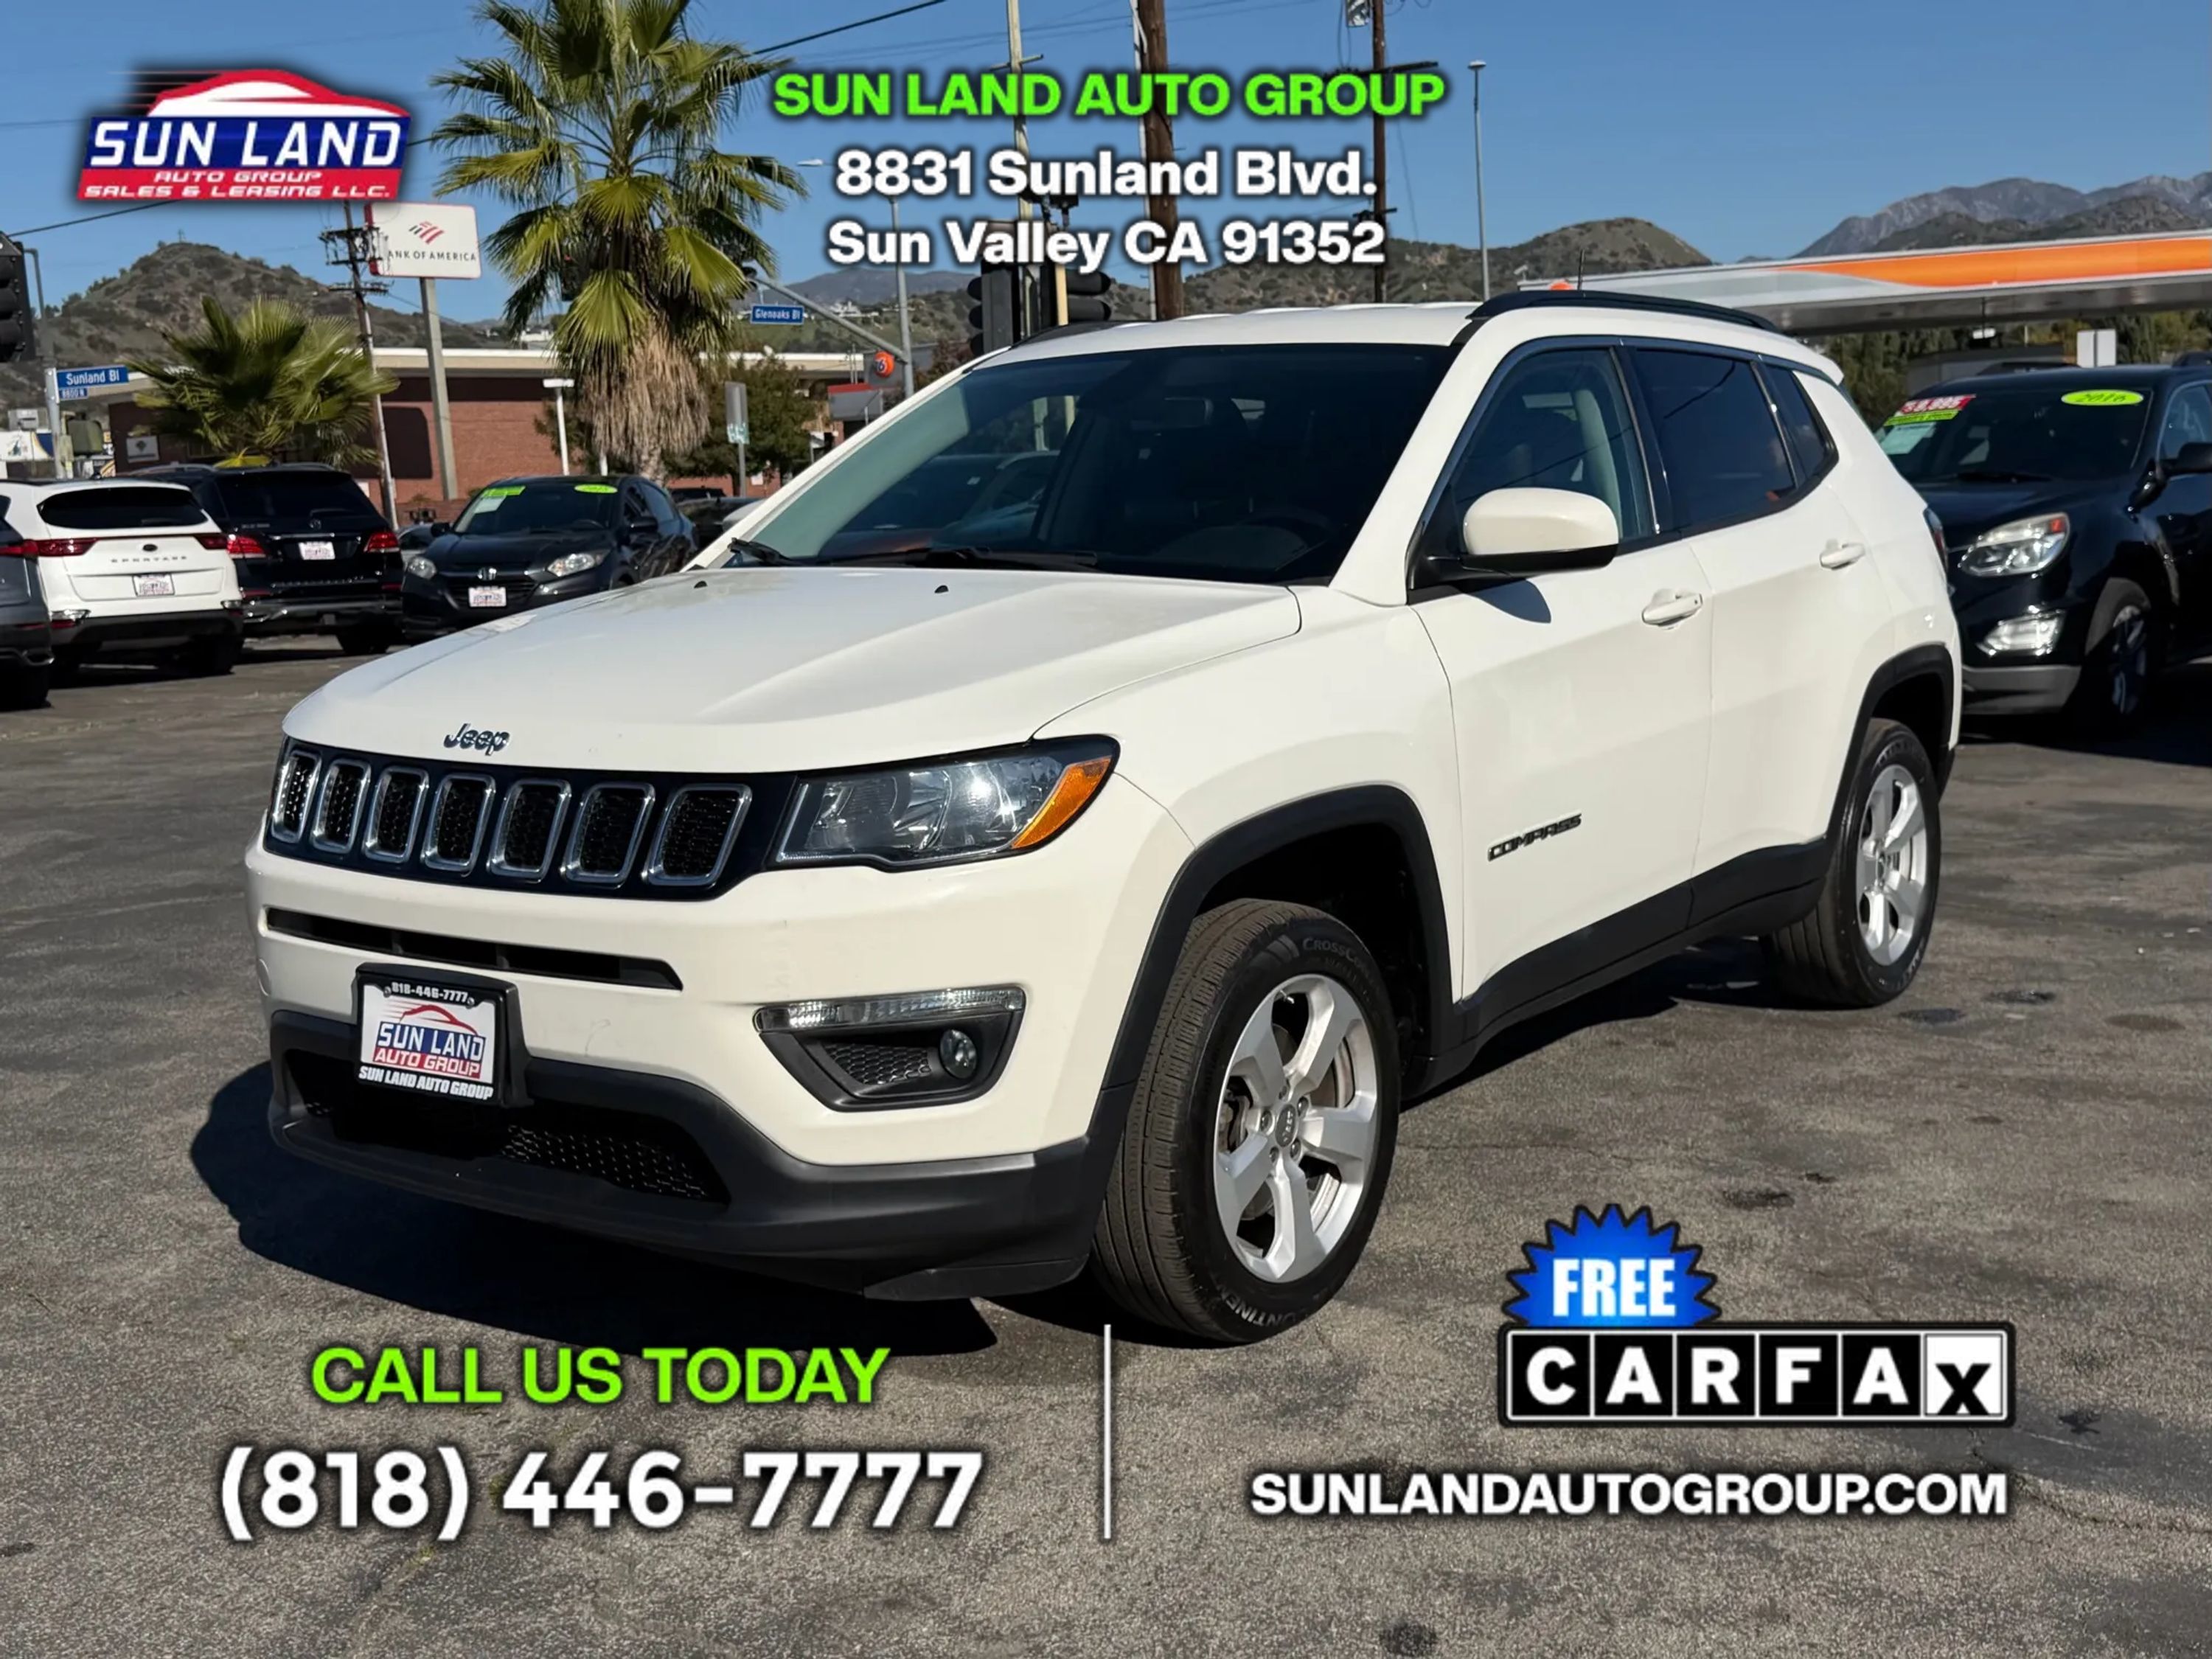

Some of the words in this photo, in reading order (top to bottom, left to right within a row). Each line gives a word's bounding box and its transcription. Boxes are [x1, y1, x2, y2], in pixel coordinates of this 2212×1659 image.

[388, 250, 410, 259] ANK
[413, 250, 425, 260] OF
[430, 251, 477, 261] AMERICA
[755, 307, 790, 319] Glenoaks
[792, 308, 801, 320] Bl
[66, 371, 105, 386] Sunland
[109, 369, 119, 382] Bl
[443, 723, 509, 757] Jeep
[1487, 813, 1582, 862] COMPASS
[391, 981, 469, 1004] 818-446-7777
[377, 1022, 425, 1051] SUN
[431, 1029, 486, 1061] LAND
[374, 1048, 420, 1068] AUTO
[422, 1054, 481, 1077] GROUP
[358, 1065, 384, 1082] SUN
[384, 1071, 418, 1090] LAND
[417, 1077, 449, 1094] AUTO
[450, 1082, 494, 1100] GROUP
